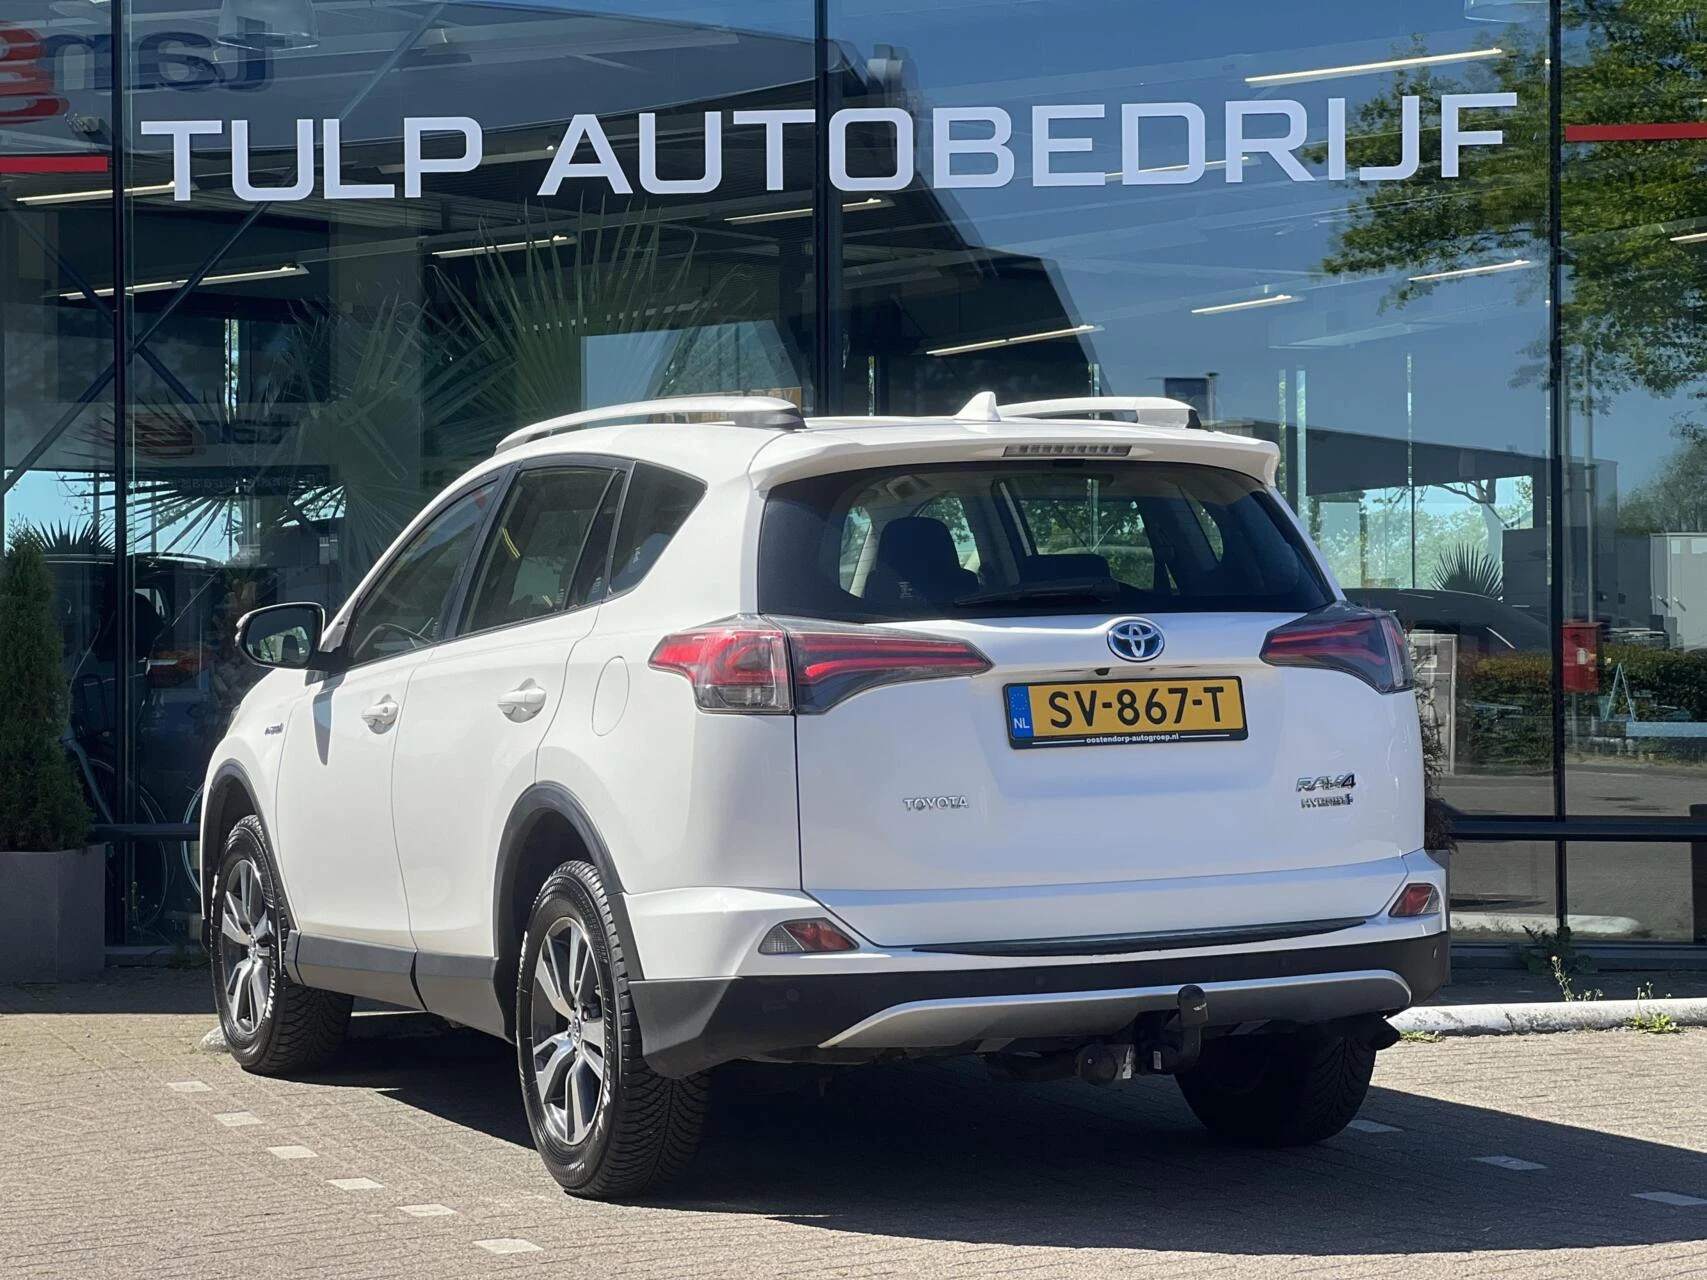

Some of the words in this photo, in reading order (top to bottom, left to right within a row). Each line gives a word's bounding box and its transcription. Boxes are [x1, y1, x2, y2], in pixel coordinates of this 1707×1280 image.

[140, 116, 483, 202] TULP
[536, 91, 1518, 196] AUTOBEDRIJF
[1048, 686, 1225, 729] SV-867-T
[1013, 717, 1030, 730] NL
[1086, 732, 1180, 744] oostendorp-autogroep.nl
[1296, 773, 1356, 792] RAV4
[902, 795, 969, 811] TOYOTA
